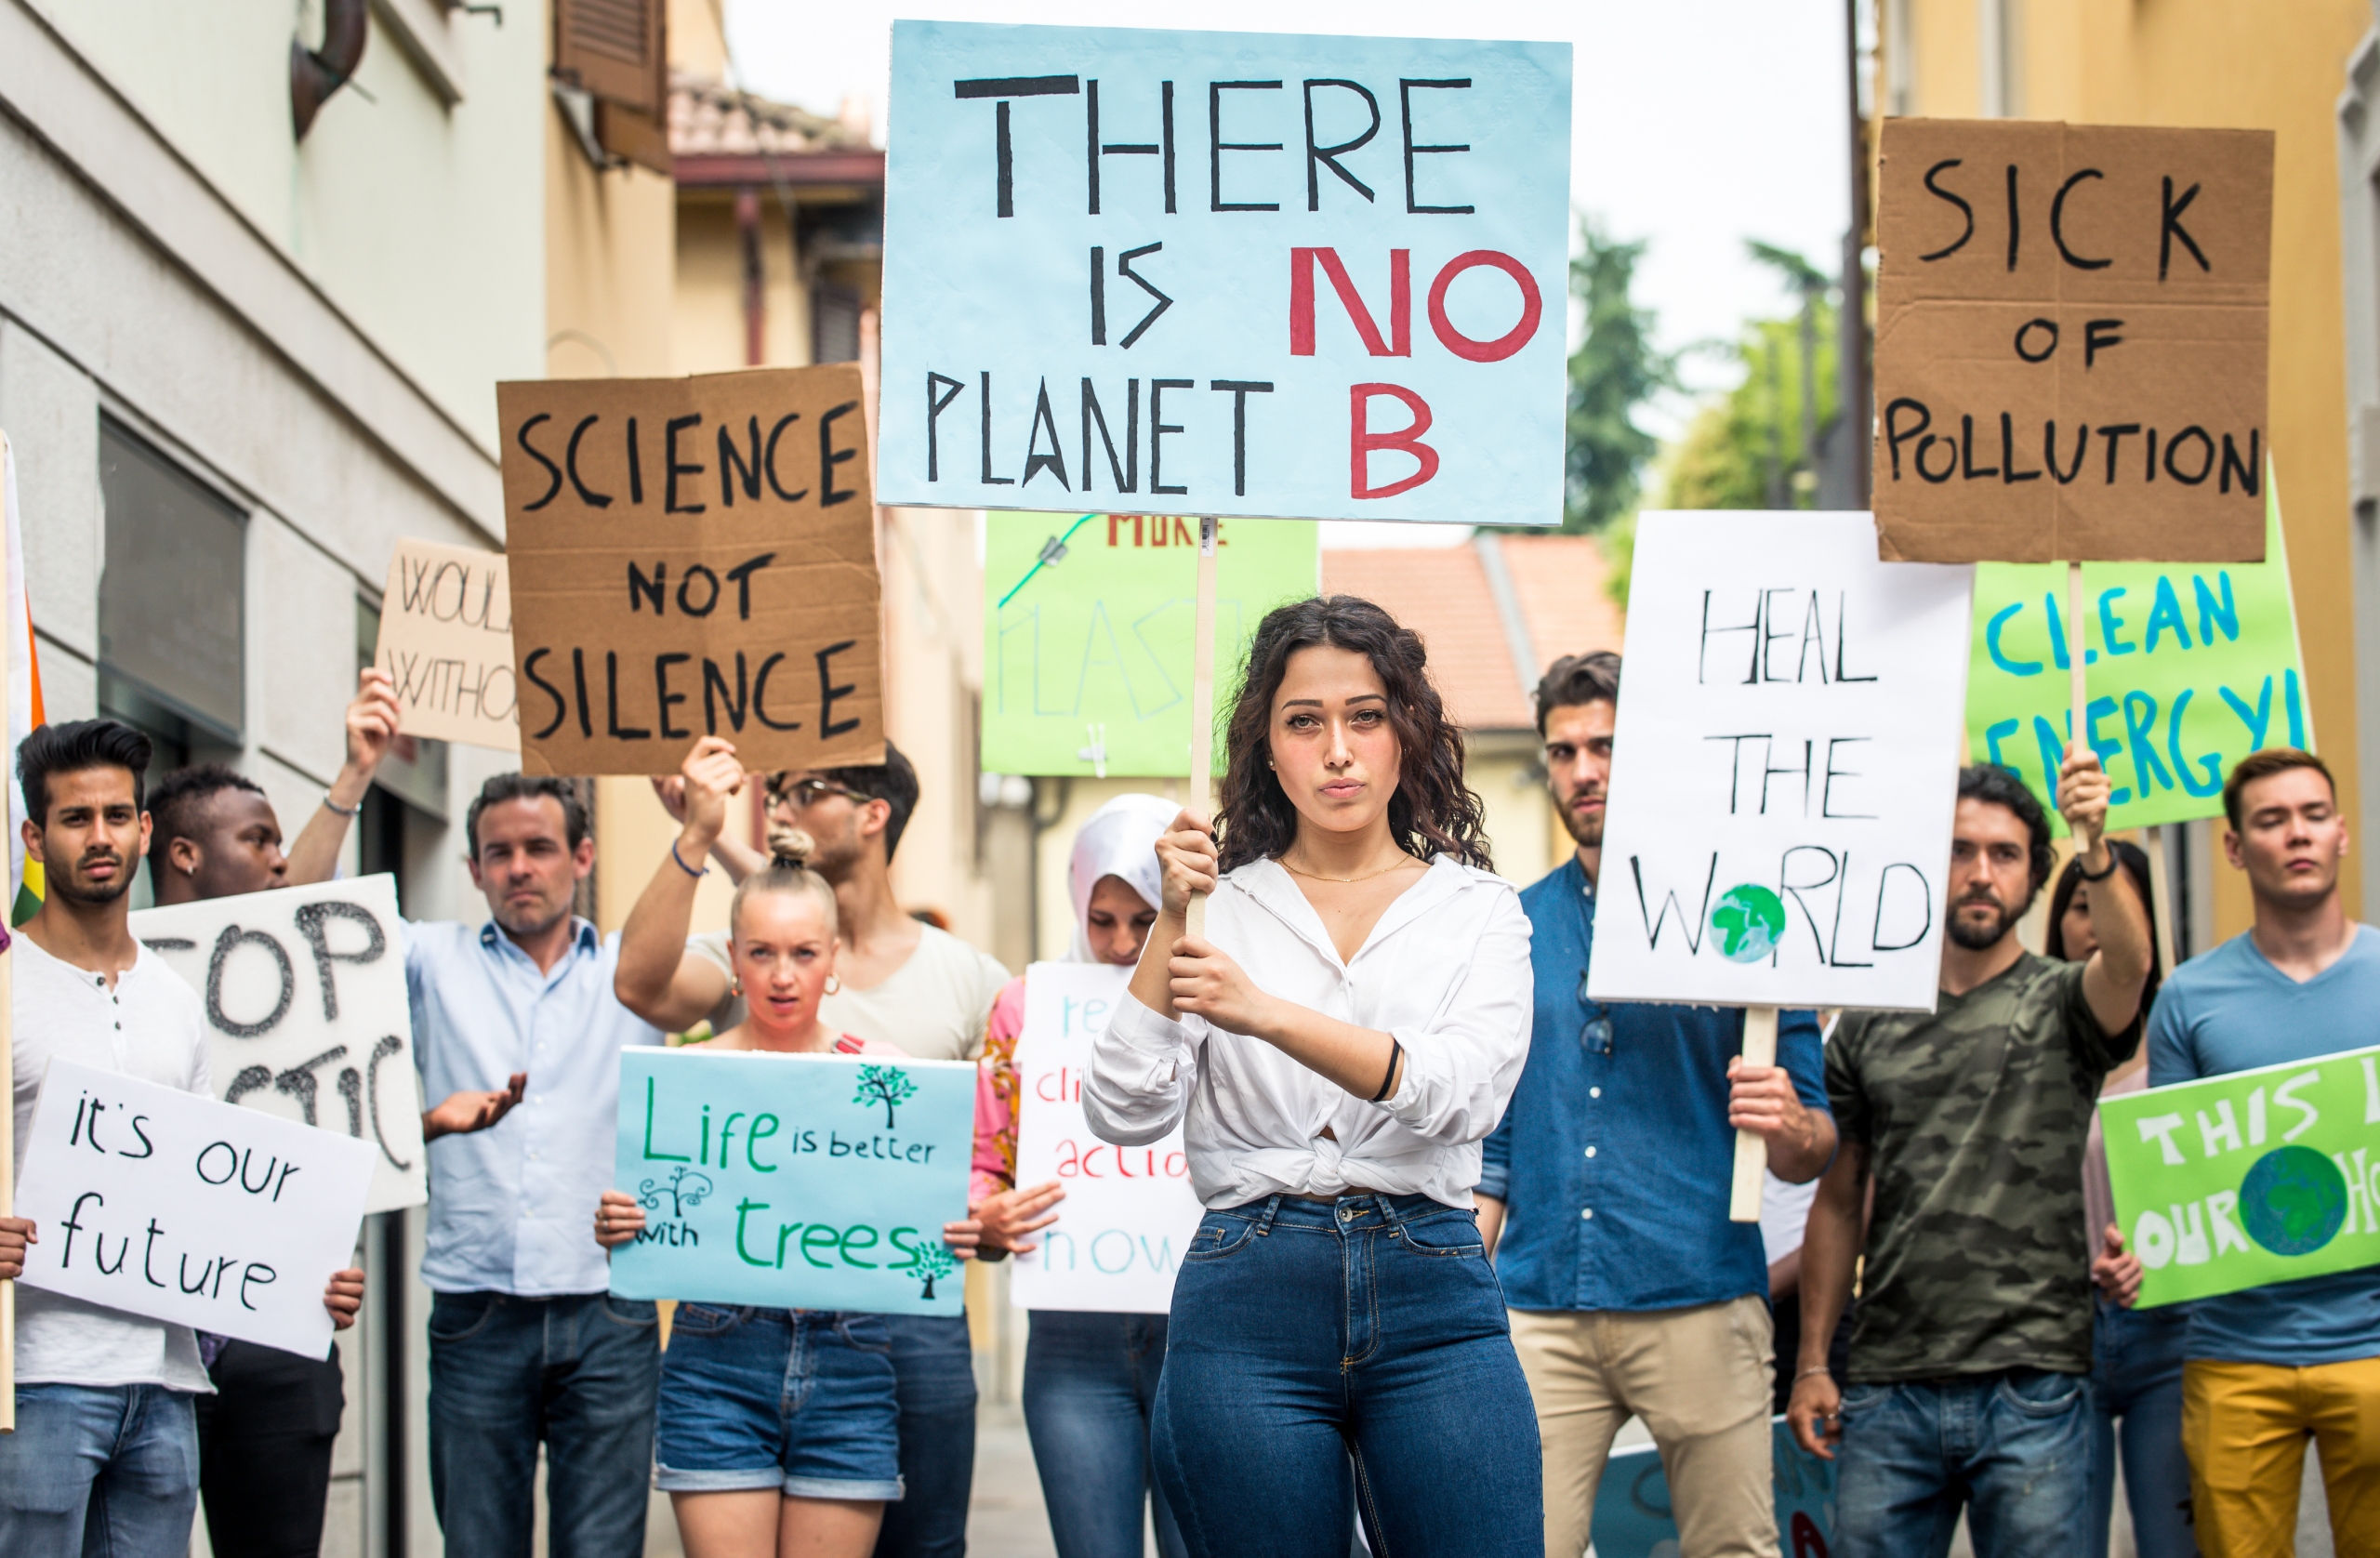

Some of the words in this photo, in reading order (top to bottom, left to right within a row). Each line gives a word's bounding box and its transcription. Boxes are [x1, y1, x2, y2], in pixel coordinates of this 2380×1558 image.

[954, 74, 1475, 218] THERE
[1918, 158, 2211, 284] SICK
[1090, 241, 1174, 350] IS
[1289, 246, 1543, 363] NO
[2015, 318, 2126, 373] OF
[517, 400, 859, 515] SCIENCE
[927, 369, 1275, 497] PLANET
[1349, 382, 1440, 500] B
[1884, 397, 2259, 497] POLLUTION
[401, 554, 511, 634] WOUL
[628, 551, 778, 621] NOT
[1986, 570, 2241, 677] CLEAN
[1699, 587, 1879, 685] HEAL
[387, 648, 521, 726] WITHO
[523, 640, 862, 741] SILENCE
[1702, 733, 1880, 820] THE
[70, 1089, 153, 1159] it's
[196, 1141, 301, 1203] our
[642, 1076, 780, 1172] Life
[791, 1126, 818, 1155] is
[829, 1130, 936, 1165] better
[2135, 1068, 2321, 1167] THIS
[60, 1191, 277, 1312] future
[635, 1221, 699, 1248] with
[735, 1196, 922, 1271] trees
[1043, 1228, 1178, 1275] now
[2133, 1189, 2251, 1271] OUR
